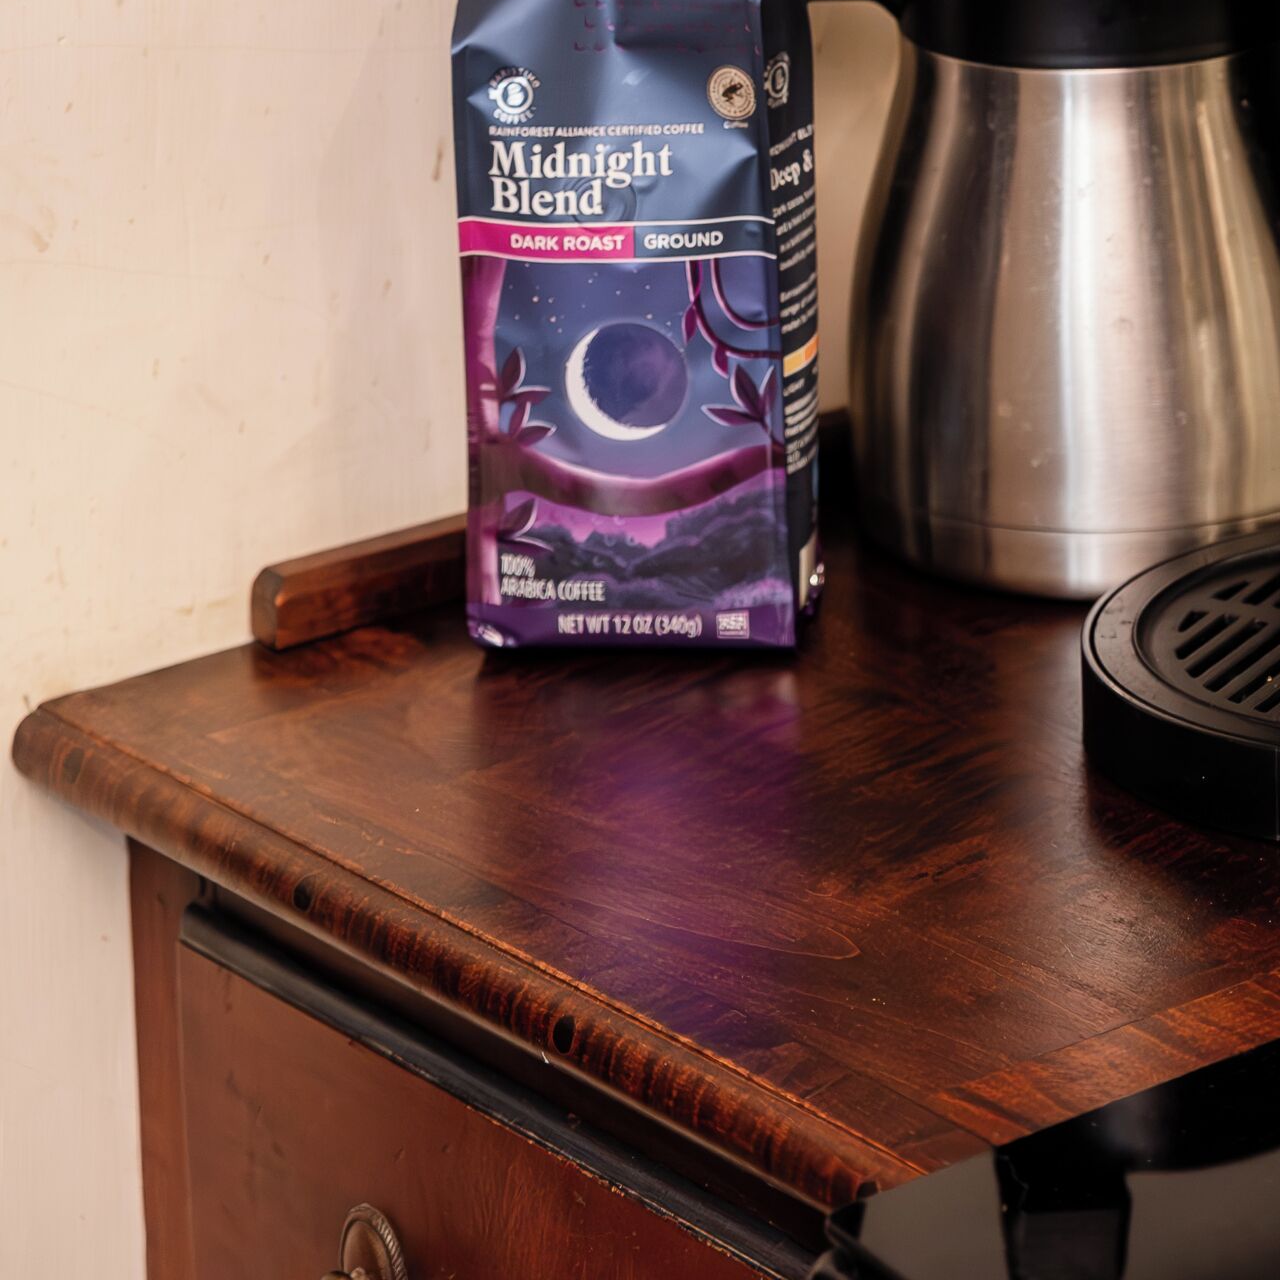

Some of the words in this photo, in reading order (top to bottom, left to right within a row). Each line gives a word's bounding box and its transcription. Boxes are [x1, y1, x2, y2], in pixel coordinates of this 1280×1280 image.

[493, 108, 534, 125] COFFEE
[489, 126, 554, 138] RAINFOREST
[555, 125, 605, 137] ALLIANCE
[607, 124, 661, 136] CERTIFIED
[663, 123, 705, 135] COFFEE
[488, 140, 673, 188] Midnight
[770, 161, 801, 191] Deep
[490, 176, 604, 216] Blend
[510, 234, 559, 251] DARK
[563, 234, 625, 251] ROAST
[644, 230, 724, 250] GROUND
[501, 553, 536, 576] 100%
[501, 576, 556, 600] ARABICA
[557, 580, 606, 602] COFFEE
[558, 614, 585, 634] NET
[586, 614, 610, 634] WT
[612, 615, 631, 634] 12
[633, 614, 653, 634] OZ
[654, 614, 702, 638] (340g)
